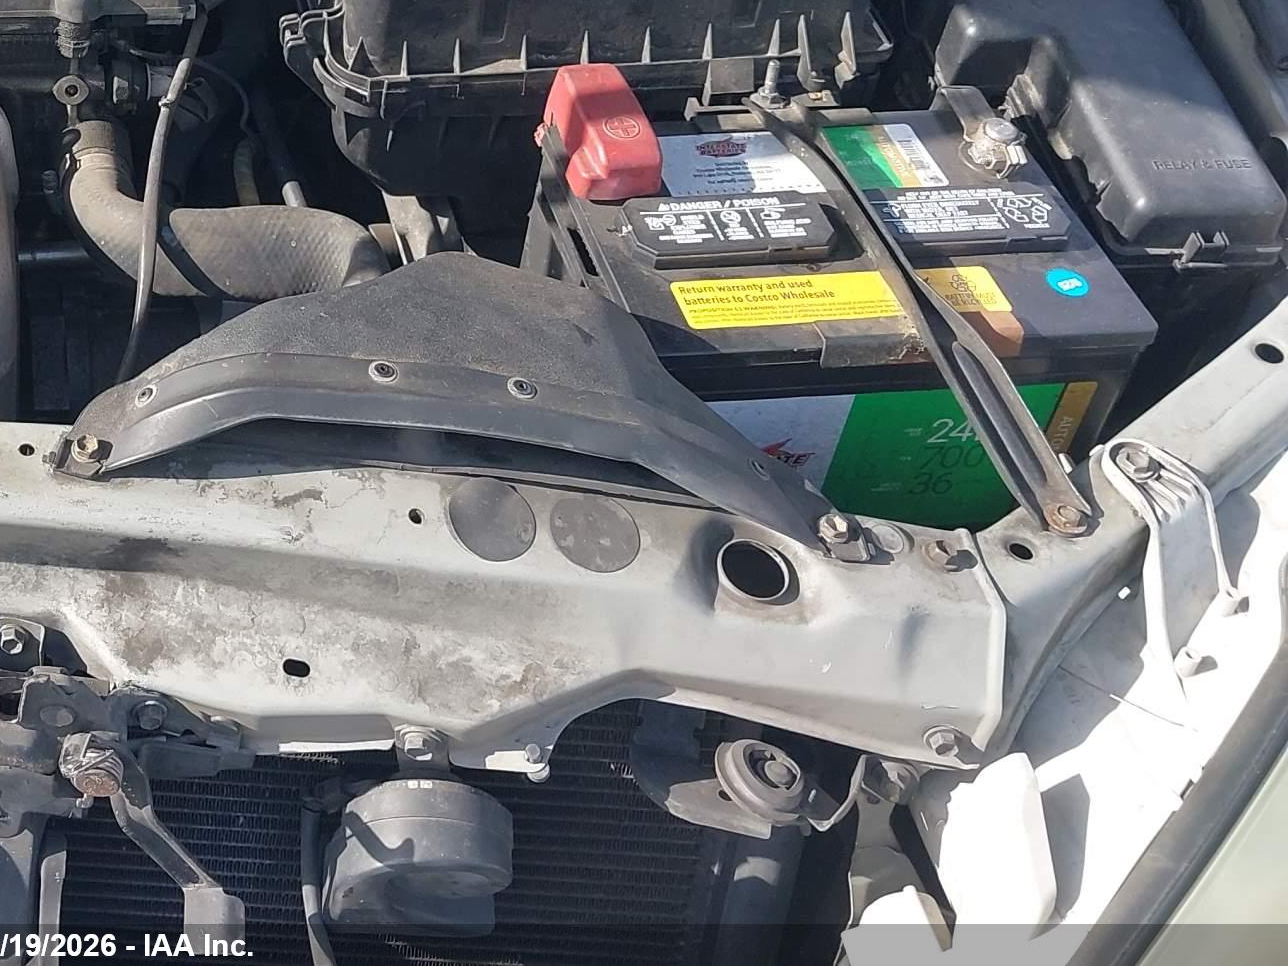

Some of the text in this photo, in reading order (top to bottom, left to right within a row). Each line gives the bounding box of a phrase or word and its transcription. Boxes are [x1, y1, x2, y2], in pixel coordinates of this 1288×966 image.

[1152, 160, 1196, 170] RELAY
[1214, 159, 1252, 170] FUSE
[671, 196, 780, 211] DANGER / POISON
[679, 280, 813, 295] Return warranty and used
[684, 290, 836, 306] batteries to Costco Wholesale
[927, 419, 982, 442] 24
[919, 444, 985, 470] 700
[908, 471, 953, 495] 36
